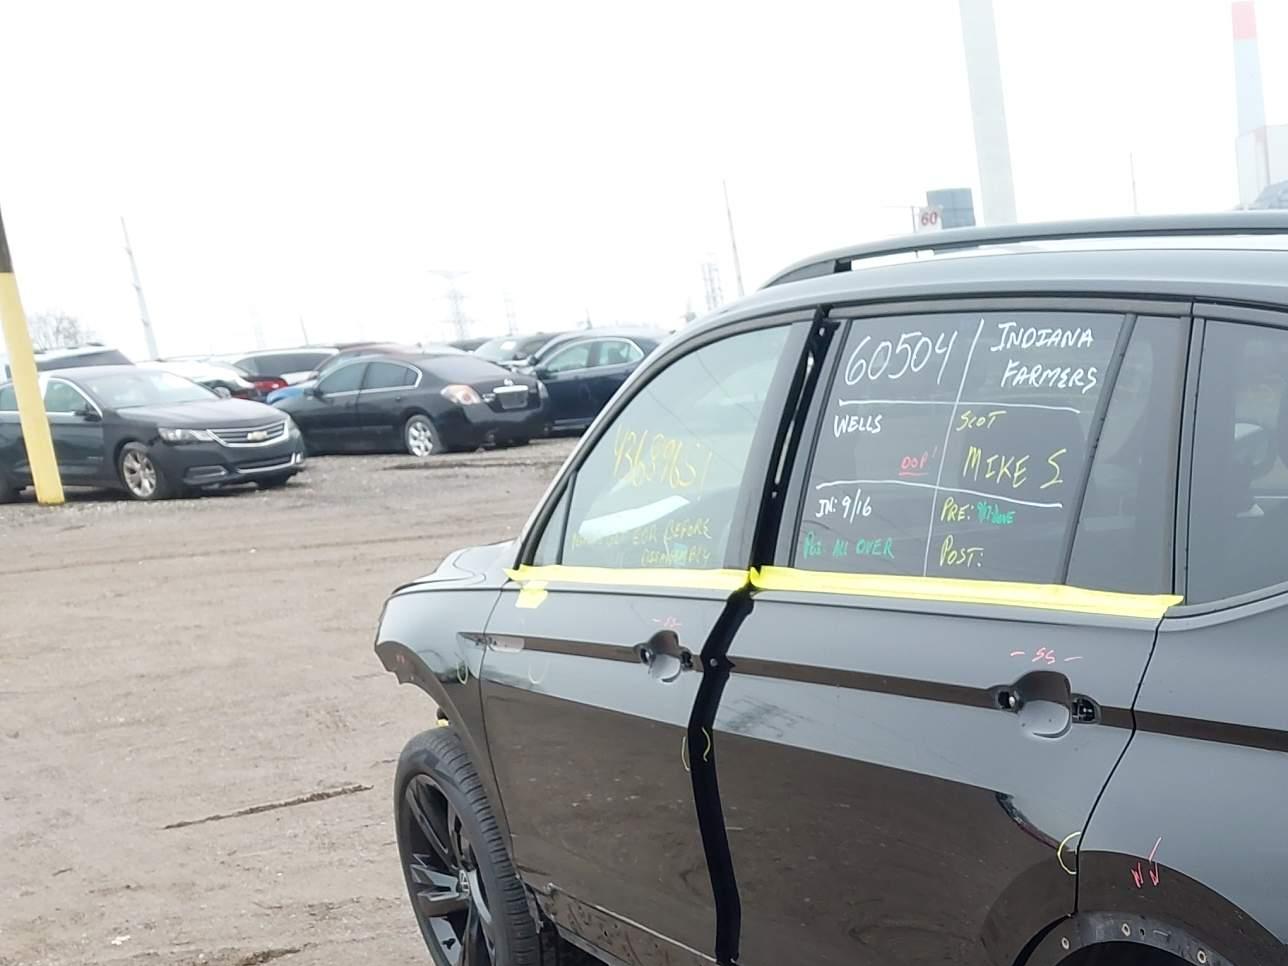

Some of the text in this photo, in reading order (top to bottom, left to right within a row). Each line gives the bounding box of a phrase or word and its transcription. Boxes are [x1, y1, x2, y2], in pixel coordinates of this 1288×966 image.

[920, 211, 938, 226] 60
[991, 322, 1094, 352] INDIANA
[845, 331, 958, 385] 60504
[1001, 360, 1098, 394] FARMERS
[834, 414, 882, 437] WELLS
[956, 411, 1007, 431] SCOT
[963, 446, 1030, 488] MIKE
[842, 488, 873, 524] 9/16
[856, 537, 895, 559] OVER
[940, 534, 984, 567] POST:
